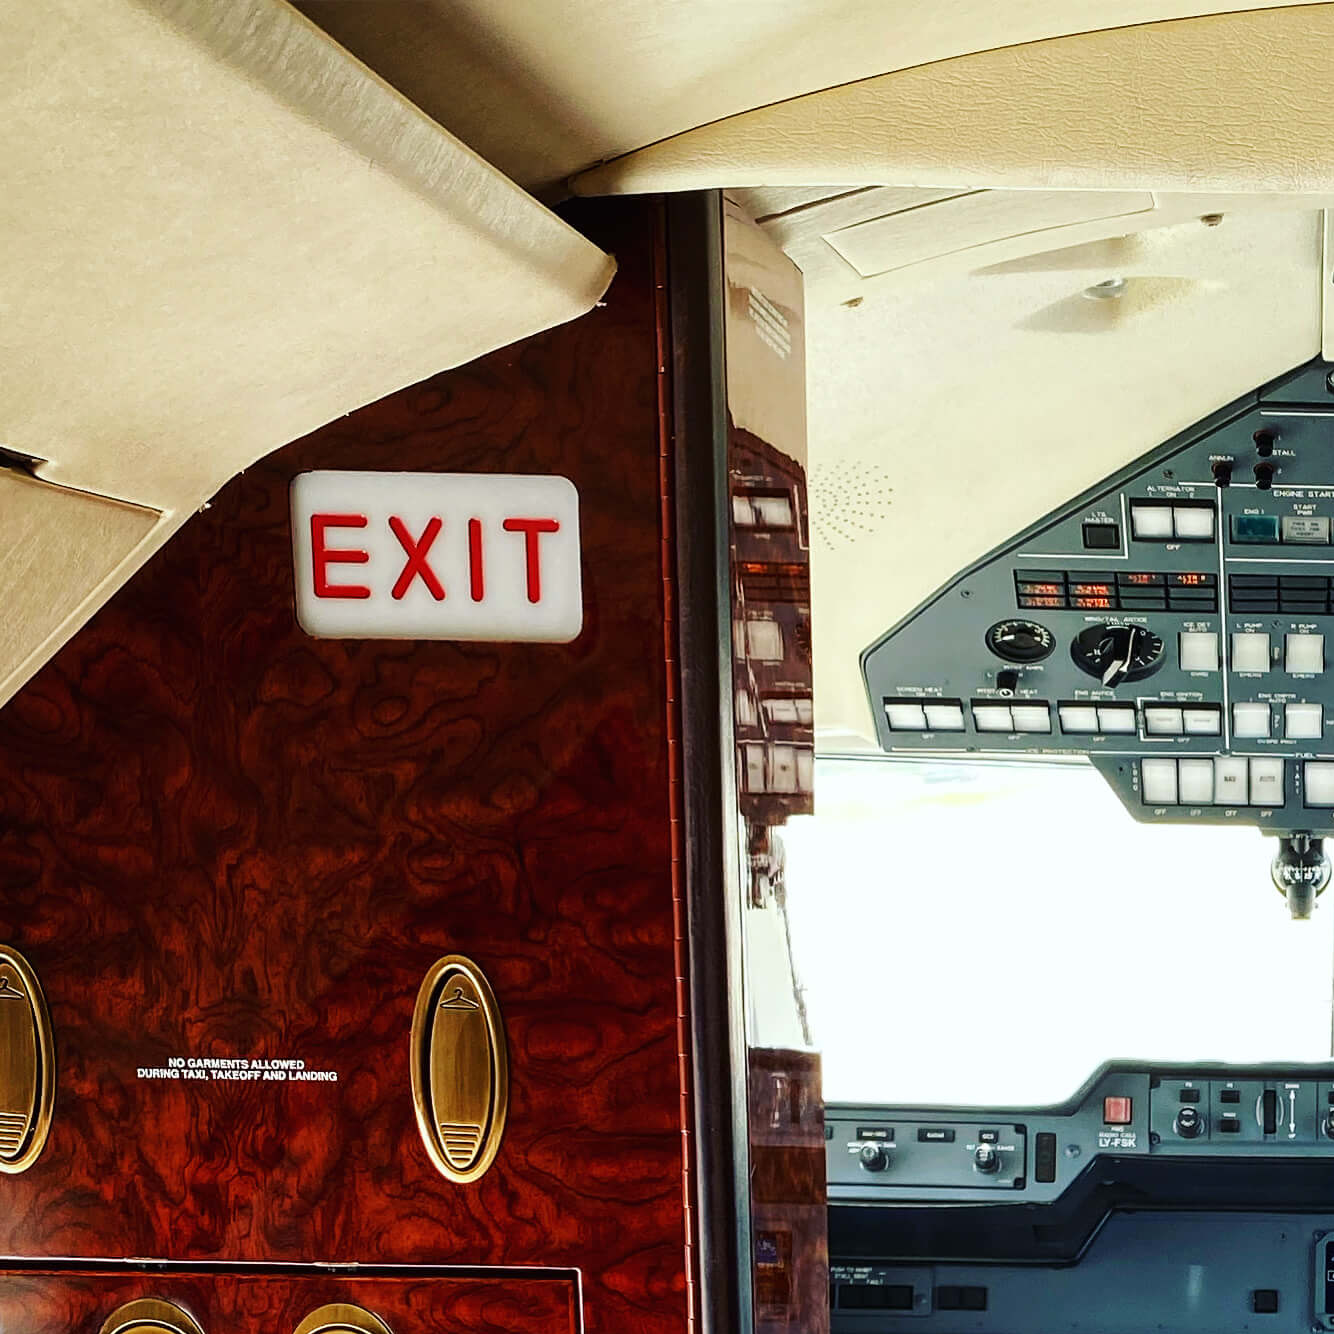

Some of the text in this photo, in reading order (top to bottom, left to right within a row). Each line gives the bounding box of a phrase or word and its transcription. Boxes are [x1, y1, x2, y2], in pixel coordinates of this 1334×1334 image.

[1272, 449, 1296, 457] STALL
[1147, 486, 1195, 494] ALTERNATOR
[1273, 490, 1304, 498] ENGINE
[311, 513, 560, 604] EXIT
[168, 1058, 305, 1070] NO GARMENTS ALLOWED
[137, 1068, 338, 1082] DURING TAXI, TAKEOFF AND LANDING
[1099, 1137, 1136, 1148] LY-FSK
